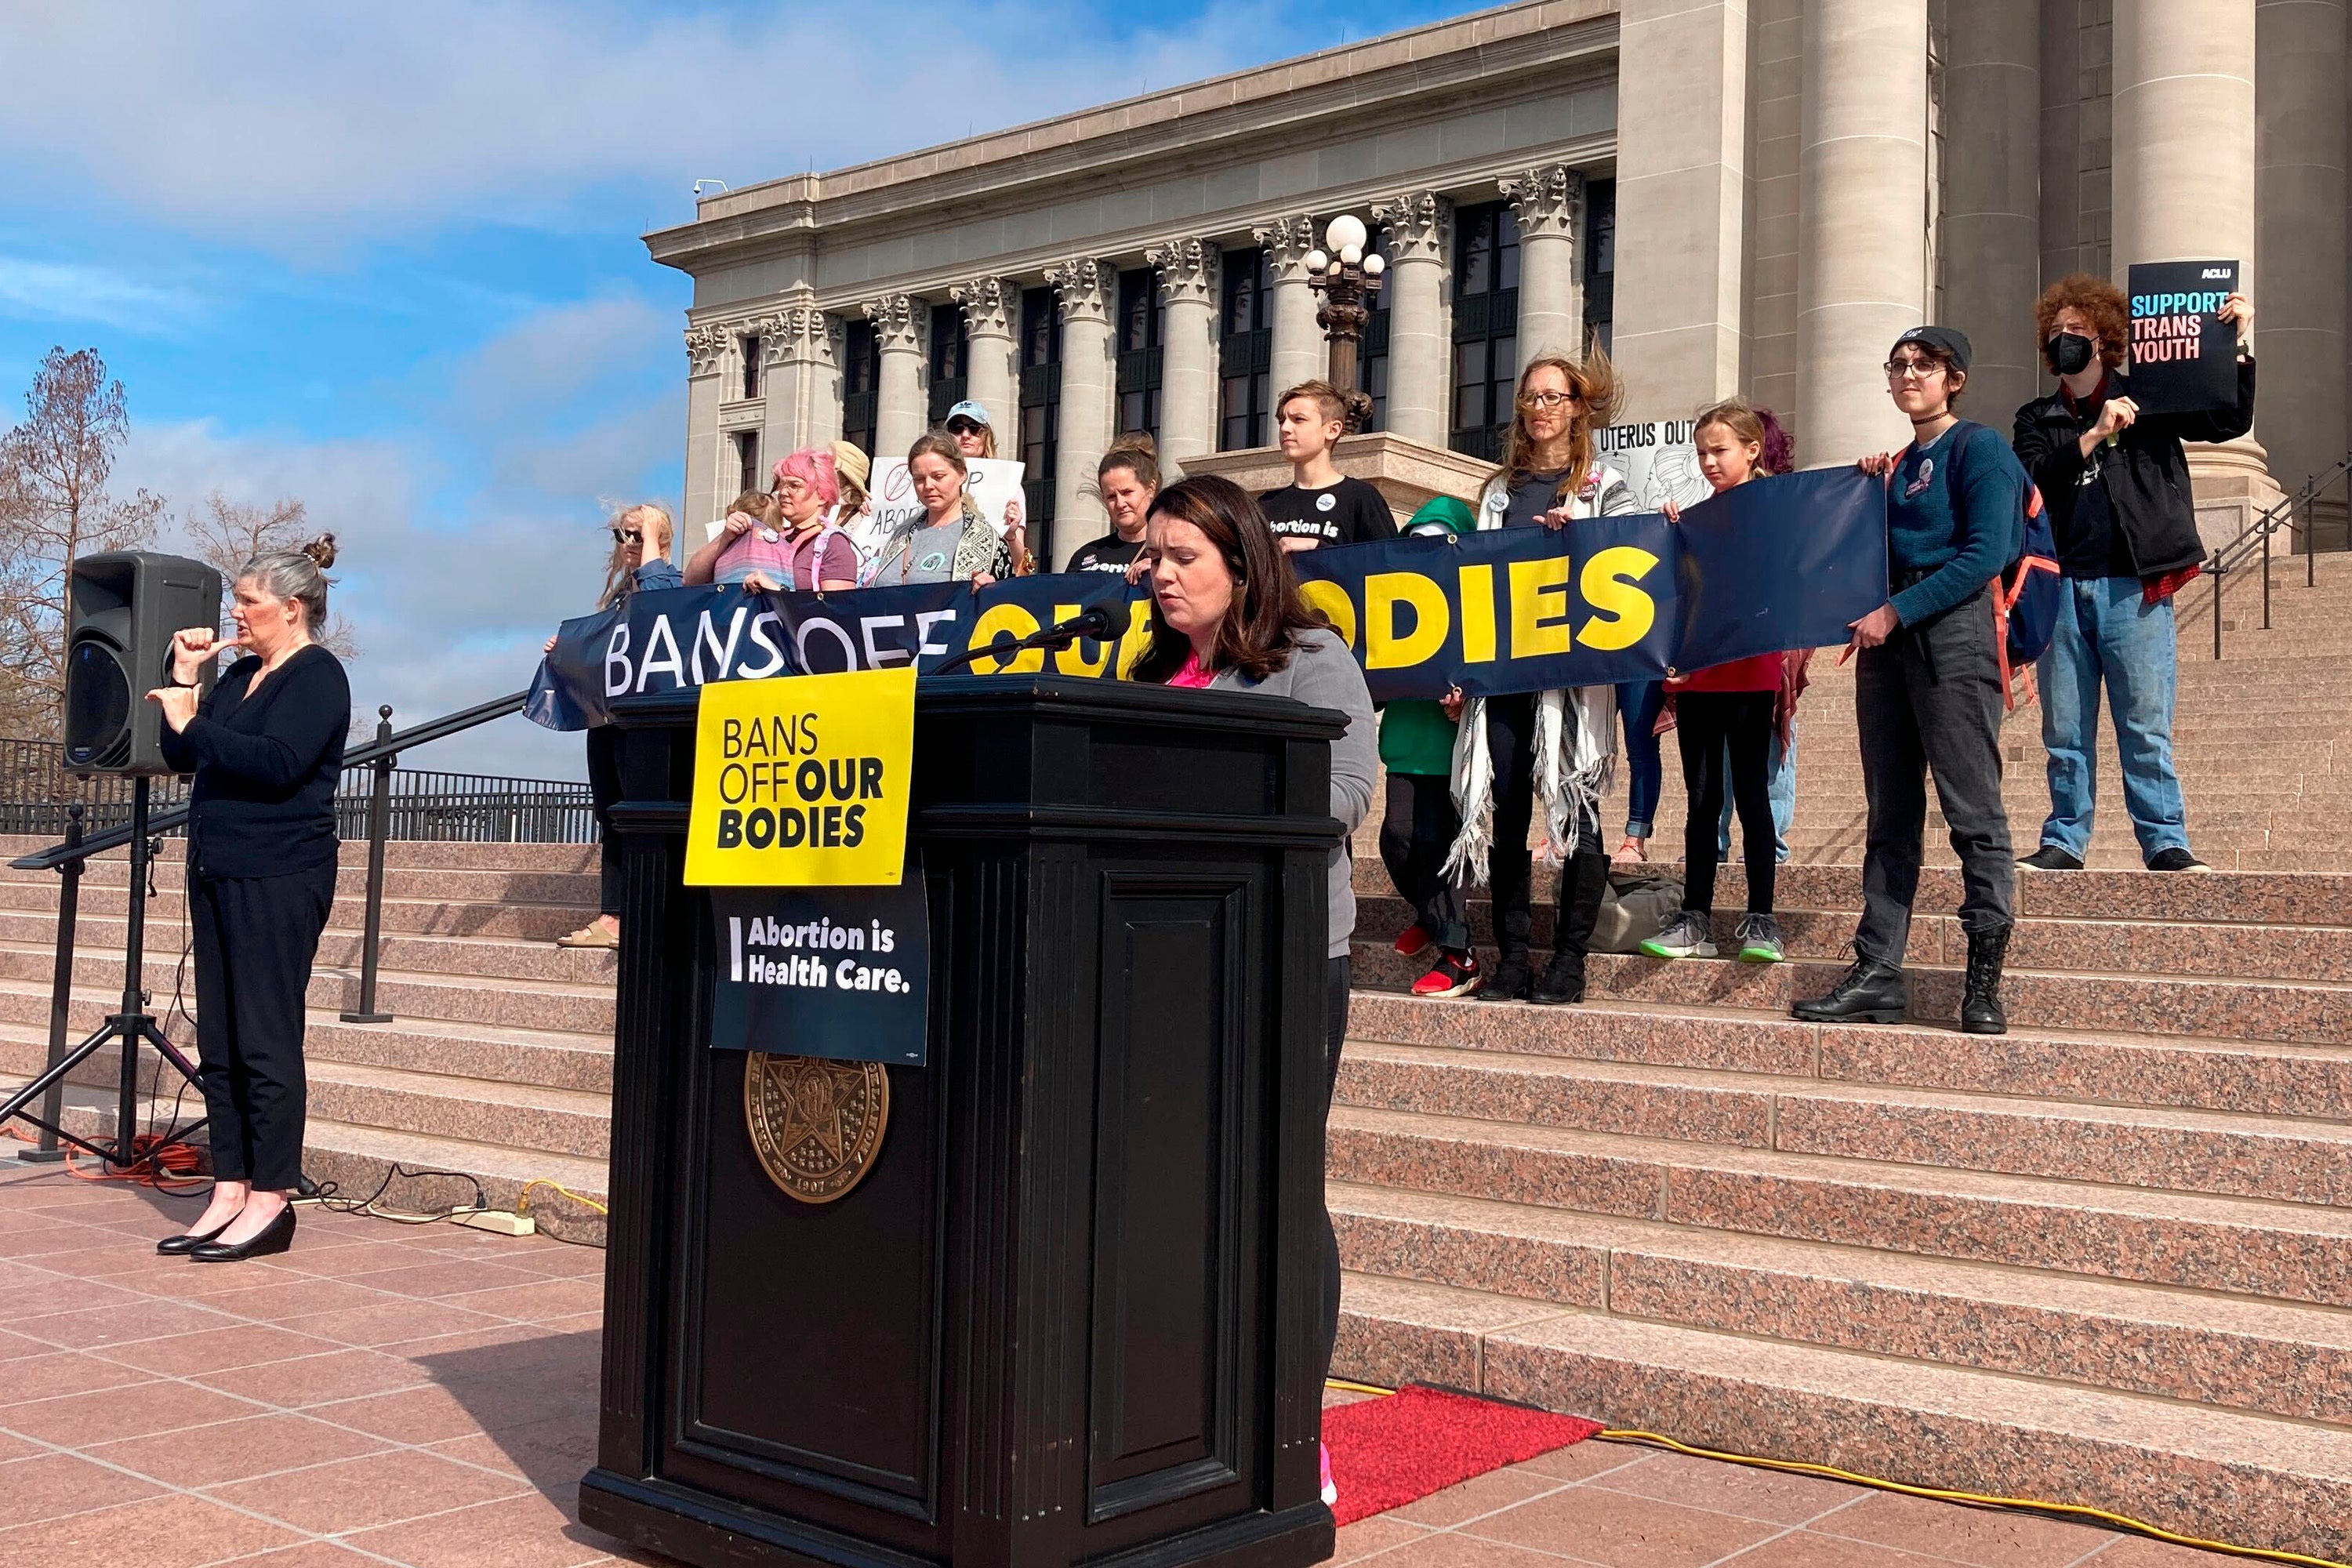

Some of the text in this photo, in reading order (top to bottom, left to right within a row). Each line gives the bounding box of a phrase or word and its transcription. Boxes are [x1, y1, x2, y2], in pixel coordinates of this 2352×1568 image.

[2201, 268, 2231, 279] ACLU
[2131, 291, 2230, 318] SUPPORT
[2131, 314, 2201, 340] TRANS
[2132, 337, 2200, 364] YOUTH
[1600, 423, 1656, 452] UTERUS
[1270, 518, 1339, 538] bortion is
[604, 607, 785, 697] BANS
[796, 608, 956, 677] OFF
[723, 712, 818, 759] BANS
[719, 757, 884, 804] OFF OUR
[717, 804, 867, 849] BODIES
[747, 915, 895, 953] Abortion is
[748, 954, 910, 993] Health Care.
[796, 1178, 826, 1192] 1907
